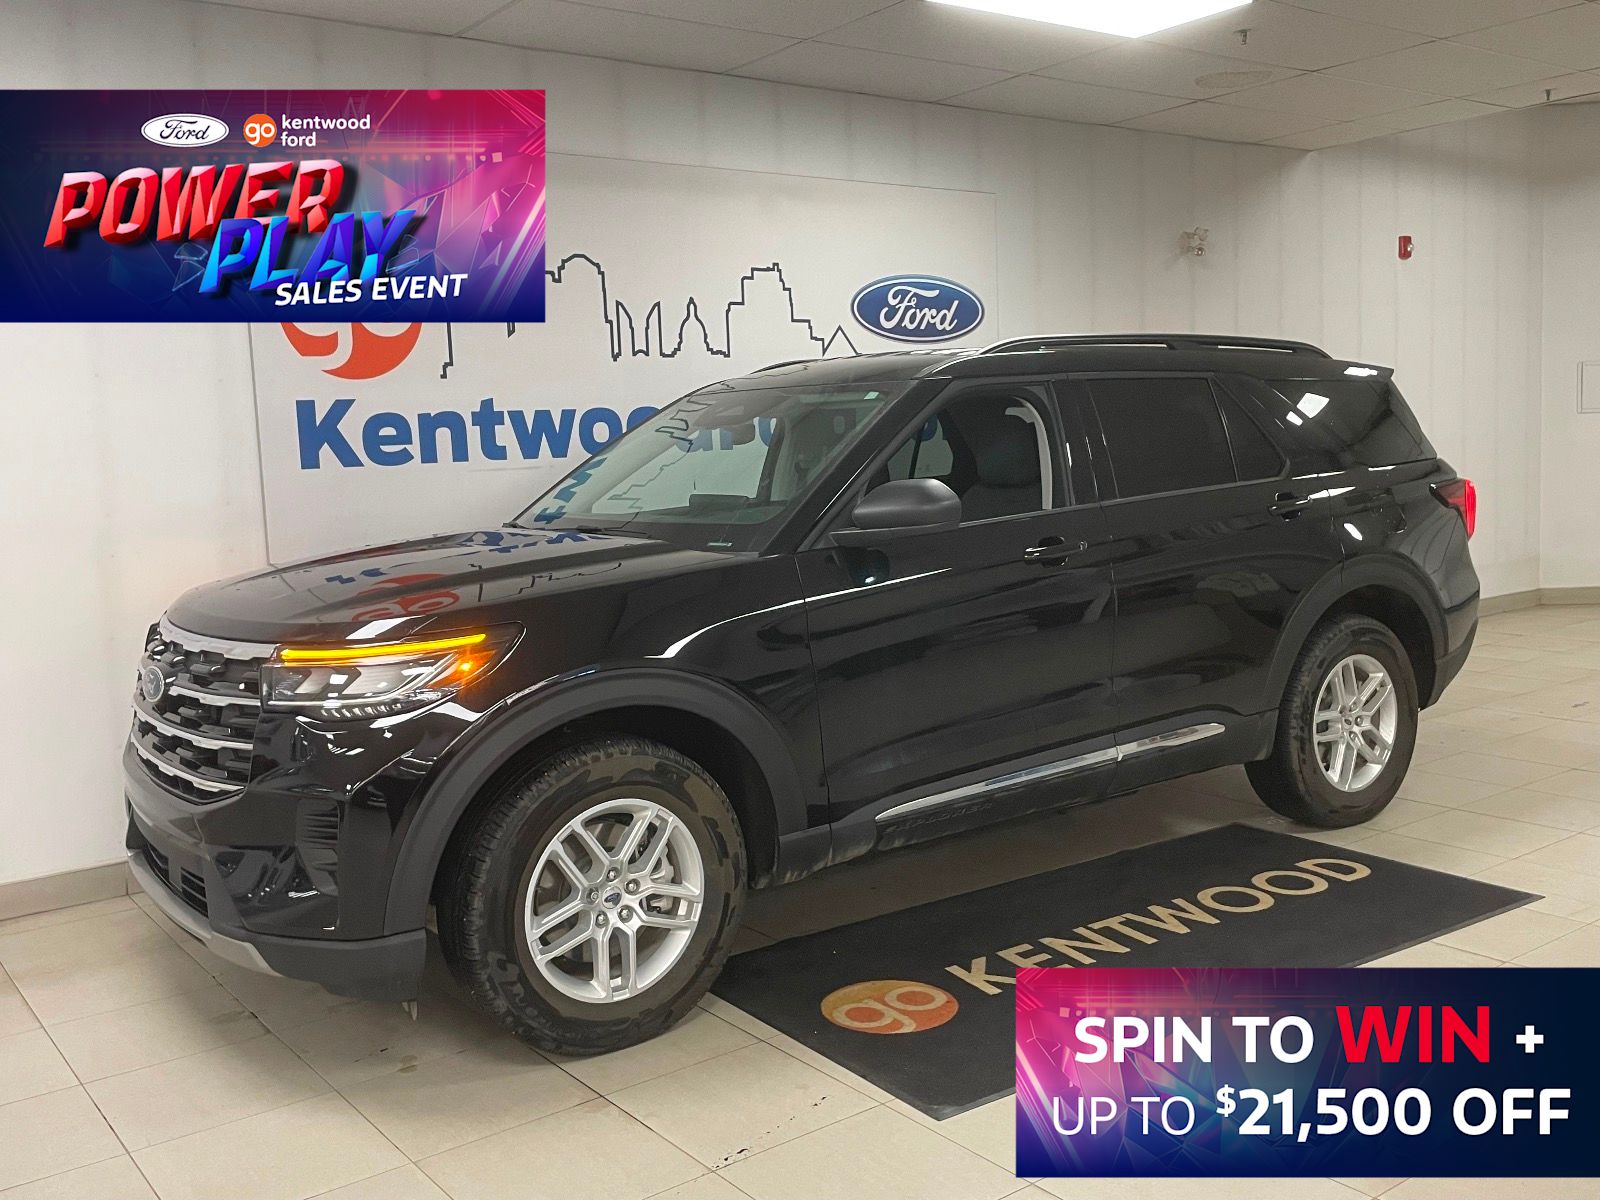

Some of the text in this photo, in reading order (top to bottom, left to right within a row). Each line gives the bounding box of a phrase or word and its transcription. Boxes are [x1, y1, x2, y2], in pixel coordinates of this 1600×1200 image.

[879, 285, 959, 331] Ford
[832, 858, 1371, 1033] go KENTWOOD
